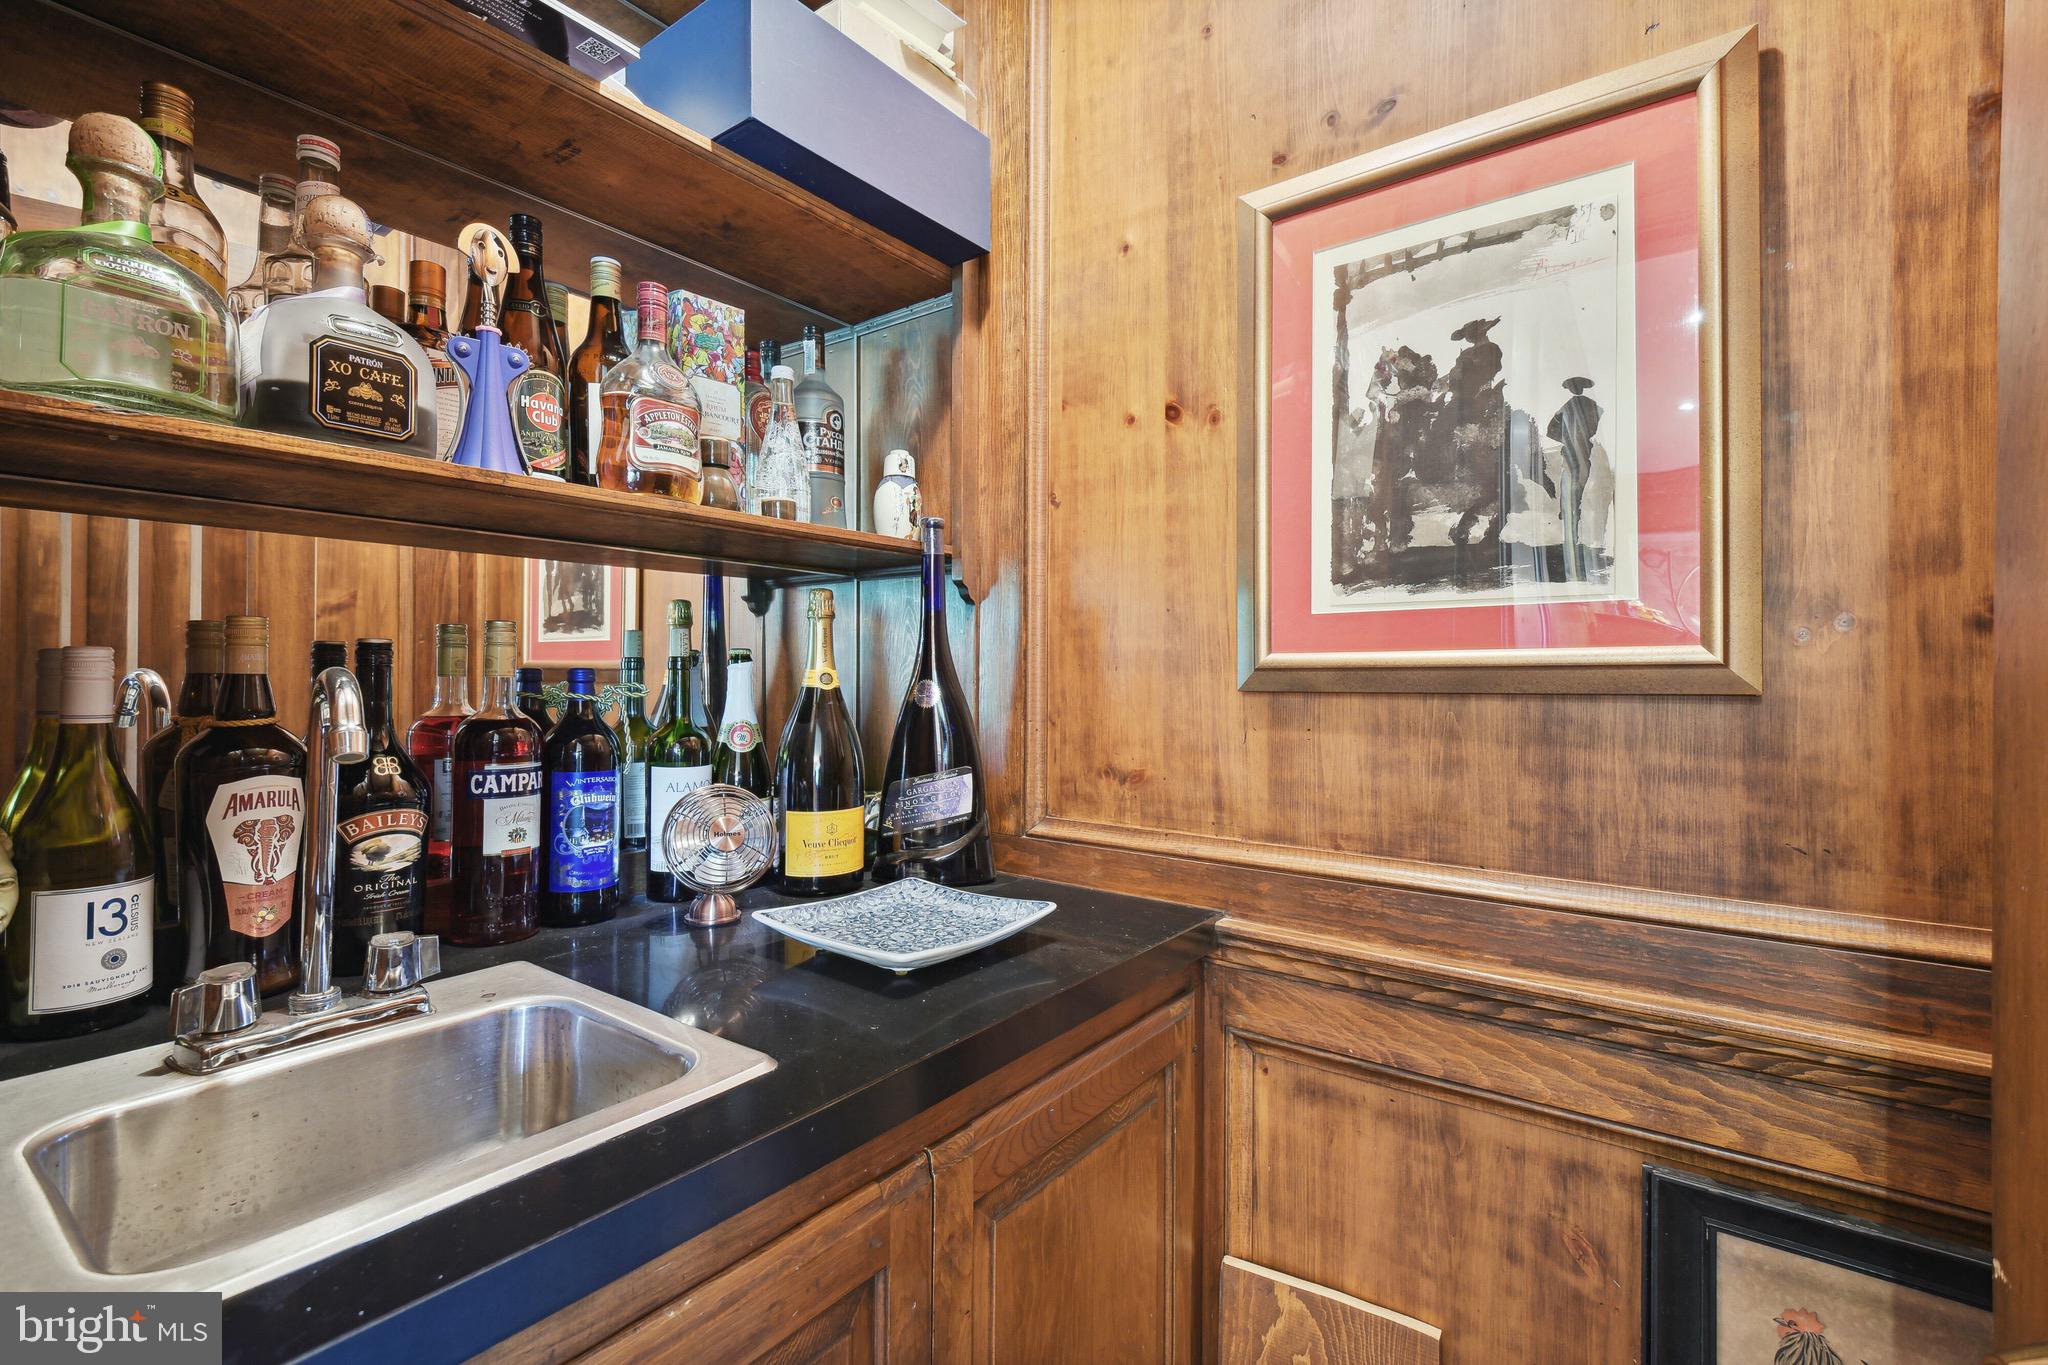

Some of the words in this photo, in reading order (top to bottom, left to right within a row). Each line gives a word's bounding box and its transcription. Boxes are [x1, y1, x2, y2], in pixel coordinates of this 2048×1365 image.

[348, 354, 384, 369] PATRÓN
[328, 360, 352, 376] XO
[360, 368, 403, 388] CAFE
[520, 394, 564, 417] Havana
[532, 411, 558, 426] Club
[644, 411, 680, 423] APPLETON
[222, 787, 301, 821] AMARULA
[895, 797, 925, 809] PINOT
[345, 812, 426, 837] BAILEYS
[802, 839, 826, 849] Veuve
[828, 836, 857, 848] Clicquot
[353, 876, 418, 893] ORIGINAL
[379, 873, 401, 883] The
[247, 887, 283, 900] CREAM
[363, 891, 386, 900] Irish
[86, 897, 129, 941] 13
[85, 940, 104, 948] NEW
[85, 972, 130, 986] SAUVIGNON
